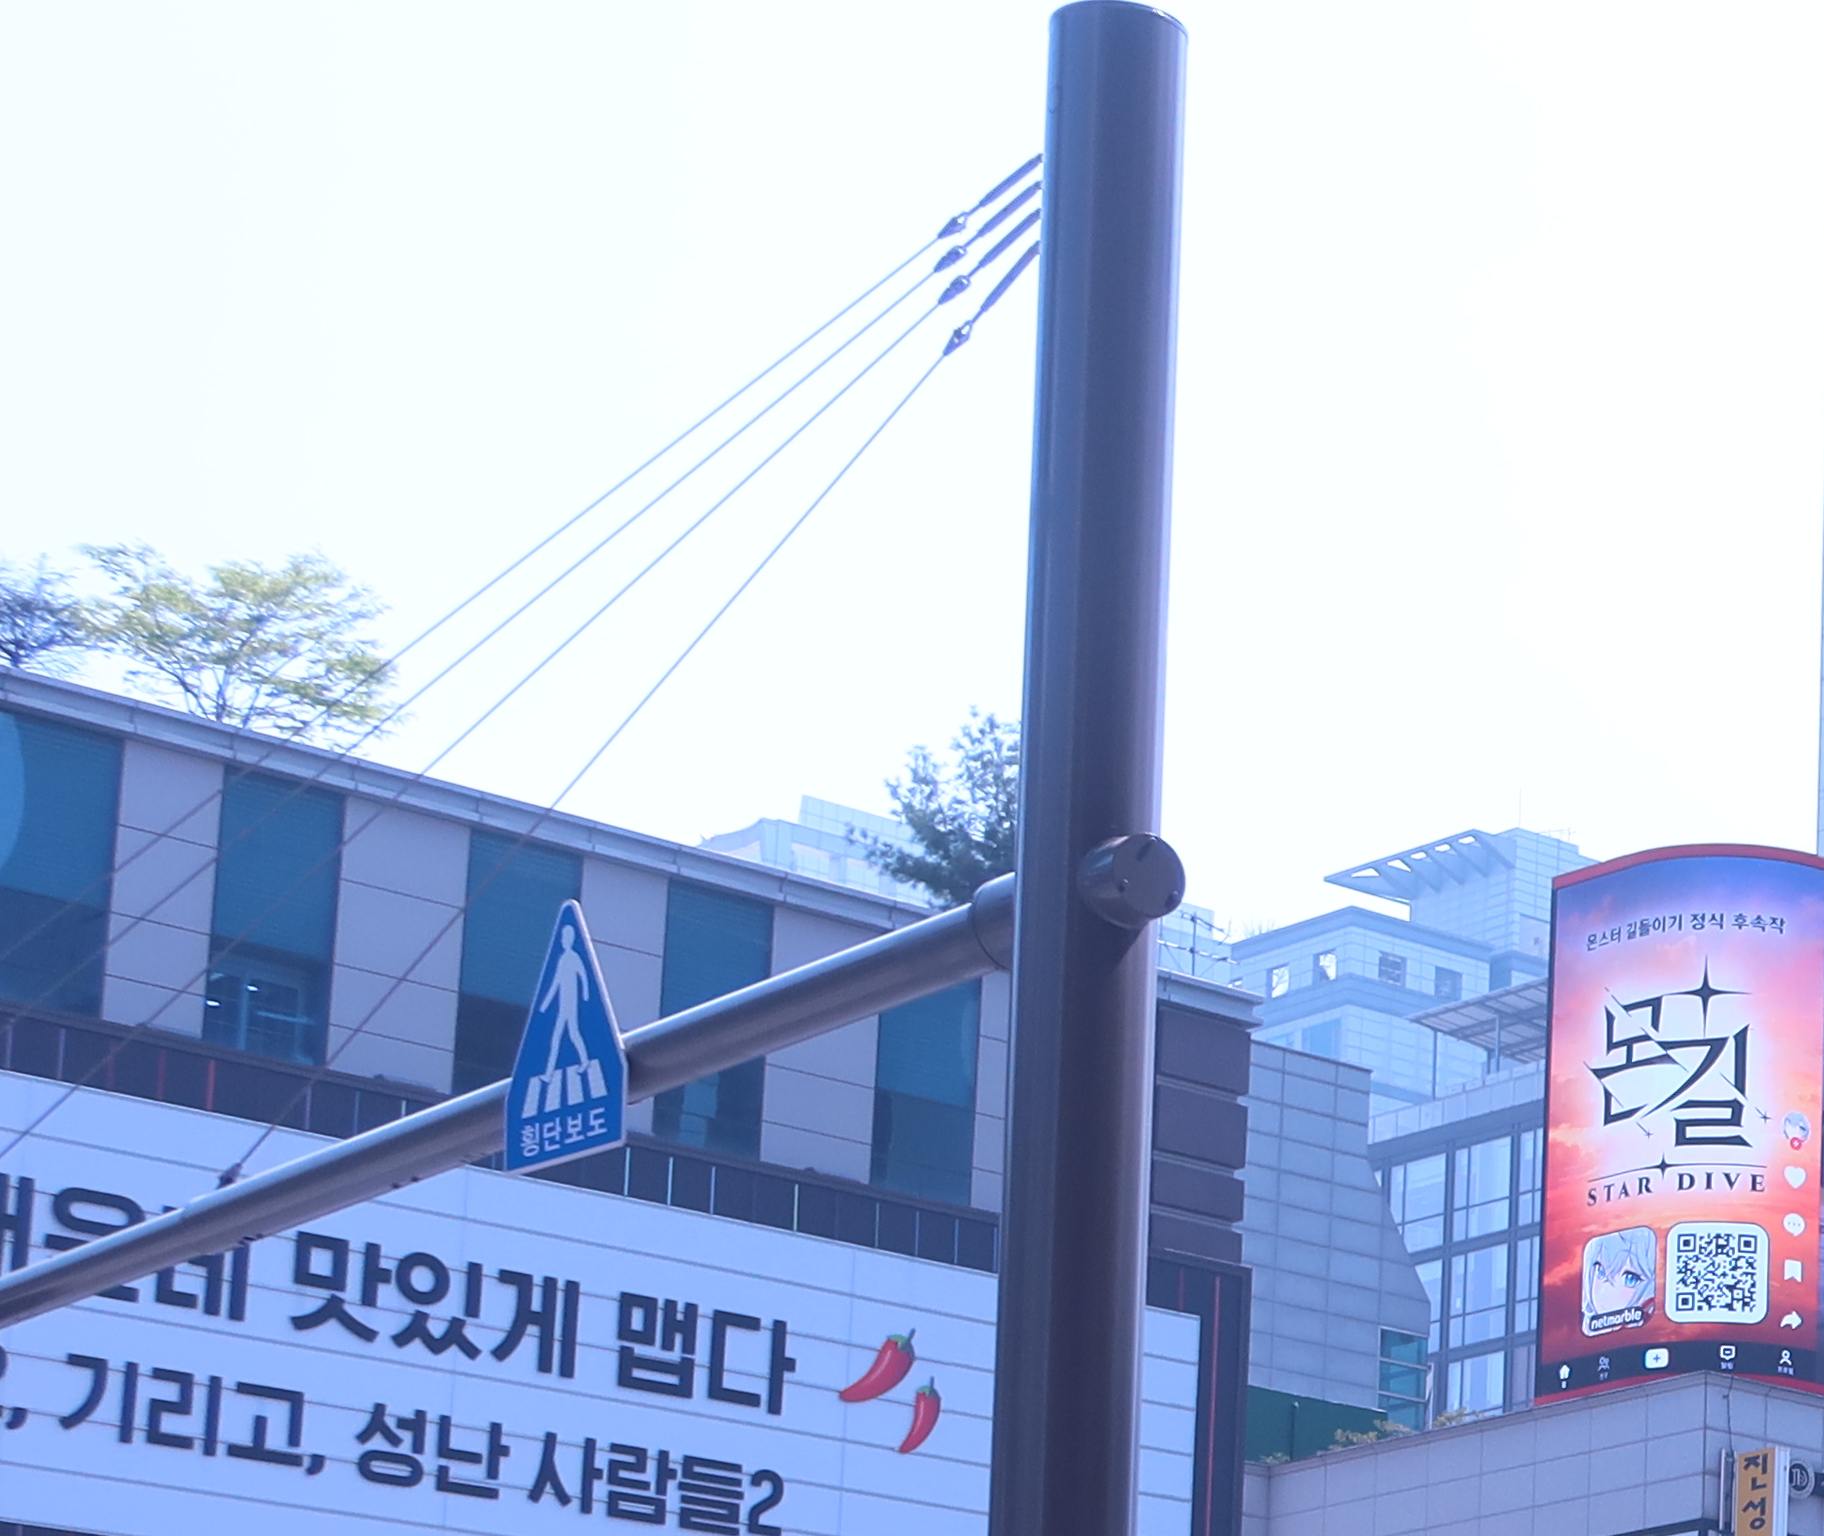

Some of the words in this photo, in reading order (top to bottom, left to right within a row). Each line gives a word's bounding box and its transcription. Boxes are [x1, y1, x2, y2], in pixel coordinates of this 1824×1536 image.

[1627, 913, 1683, 940] 길들이기
[1690, 912, 1725, 931] 정식
[1731, 912, 1786, 935] 후속작
[519, 1106, 608, 1158] 횡단보도
[1586, 1175, 1654, 1206] STAR
[1676, 1171, 1767, 1193] DIVE
[290, 1229, 581, 1379] 맛있게
[617, 1290, 797, 1415] 맵다
[1590, 1307, 1642, 1331] netmarble
[58, 1351, 326, 1476] 기리고,
[356, 1401, 511, 1500] 성난
